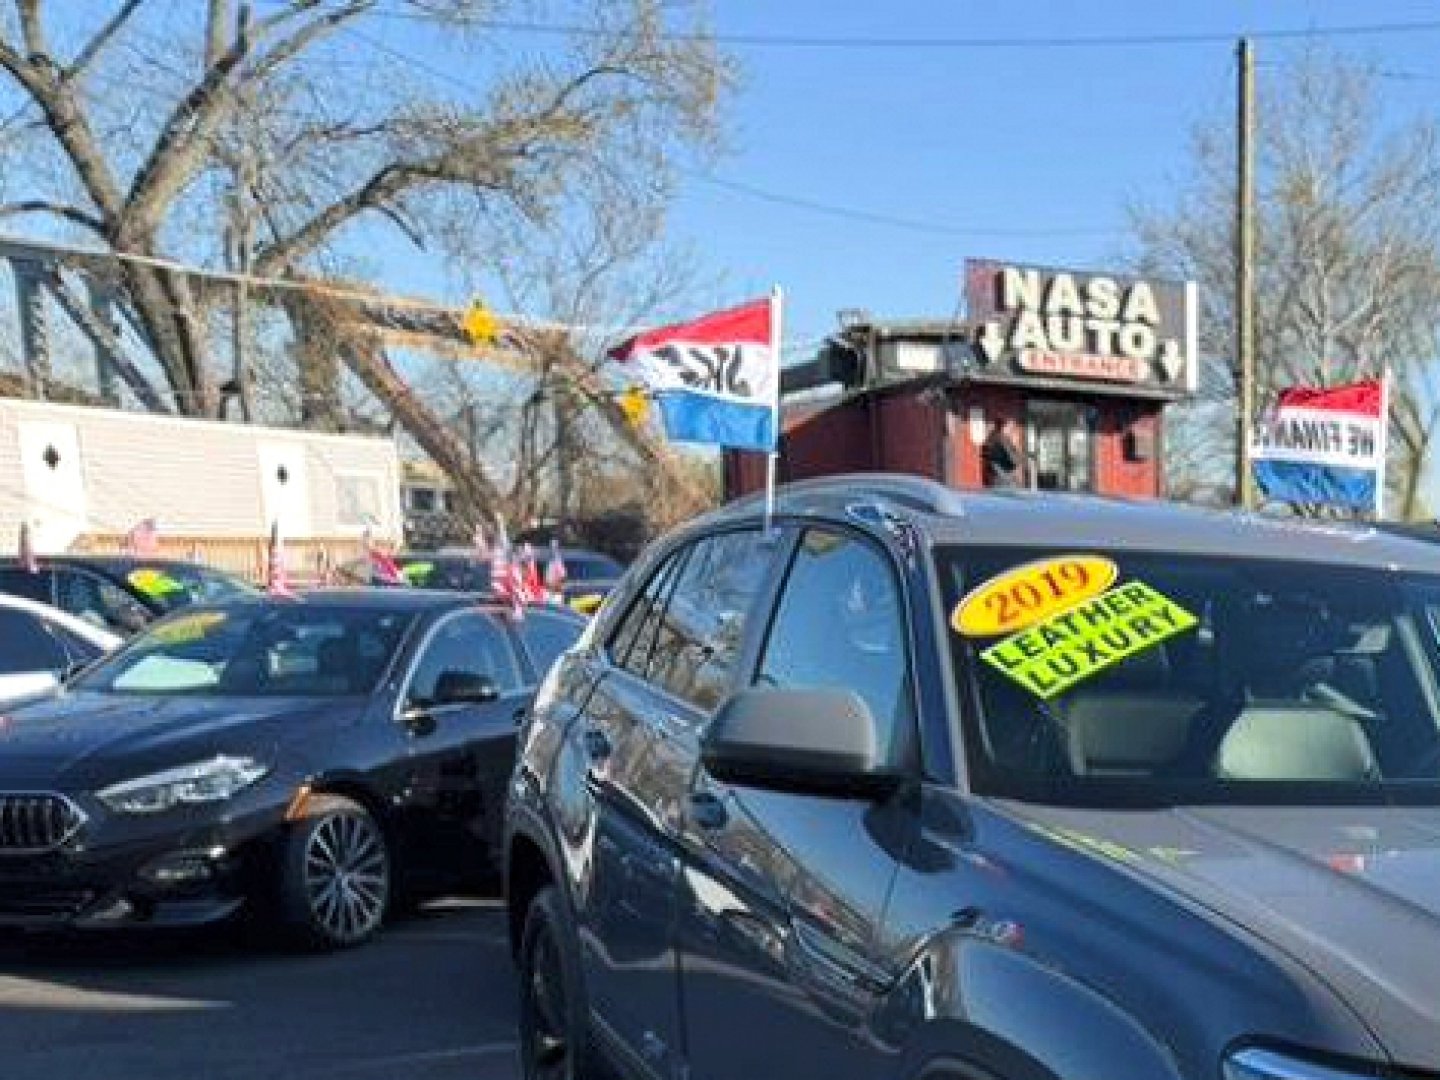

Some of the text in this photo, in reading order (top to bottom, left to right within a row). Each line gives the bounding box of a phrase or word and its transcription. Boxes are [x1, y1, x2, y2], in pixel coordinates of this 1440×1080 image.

[1003, 268, 1160, 323] NASA
[1010, 311, 1156, 357] AUTO
[985, 562, 1090, 625] 2019
[991, 585, 1151, 668] LEATHER
[1028, 606, 1176, 690] LUXURY
